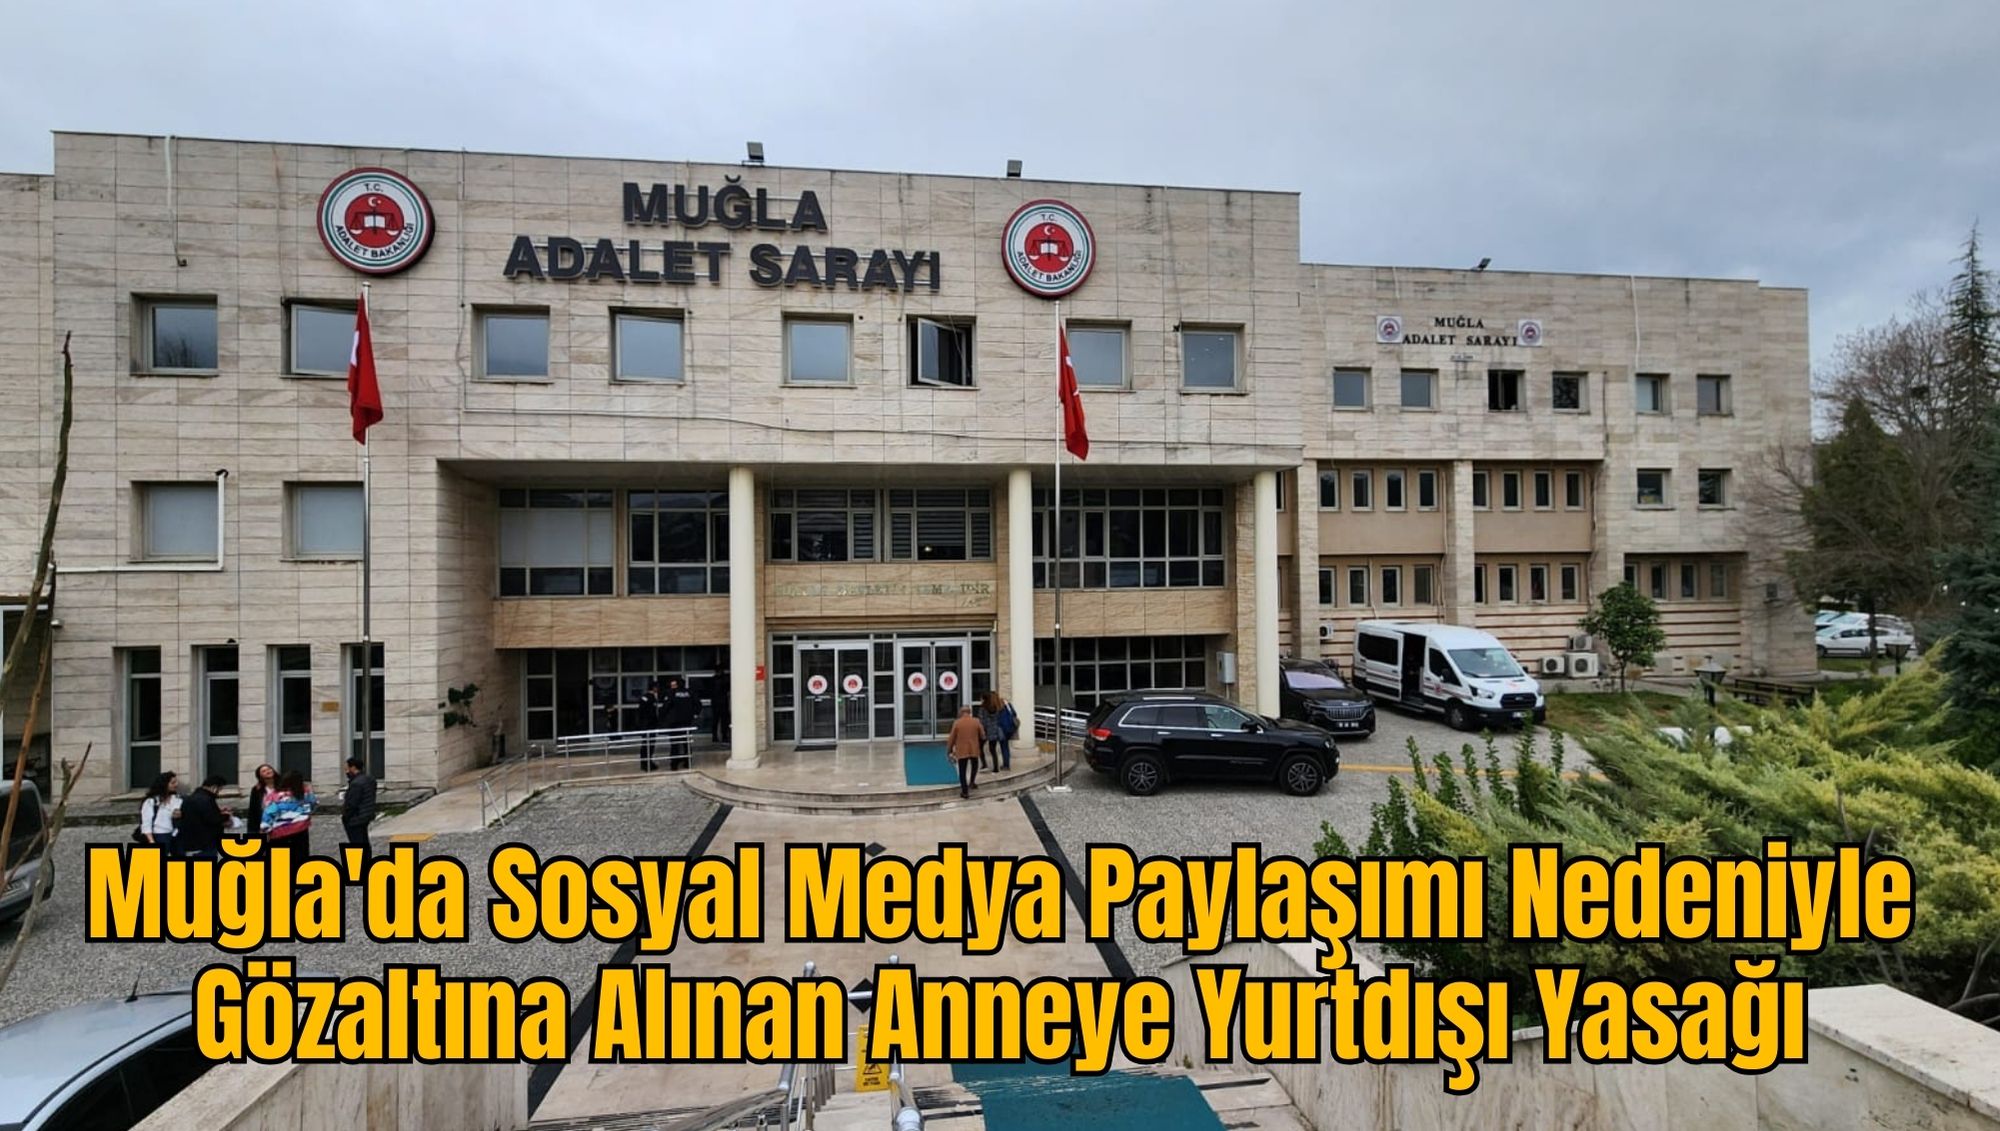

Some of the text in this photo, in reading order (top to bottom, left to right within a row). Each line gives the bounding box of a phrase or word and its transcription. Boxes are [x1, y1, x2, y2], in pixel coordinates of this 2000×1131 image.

[364, 183, 384, 192] T.C.
[622, 174, 827, 232] MUĞLA
[335, 224, 368, 257] ADALET
[503, 235, 941, 292] ADALET SARAYI
[1016, 250, 1043, 280] ADALET
[1434, 315, 1485, 329] MUĞLA
[1402, 333, 1518, 347] ADALET SARAYI
